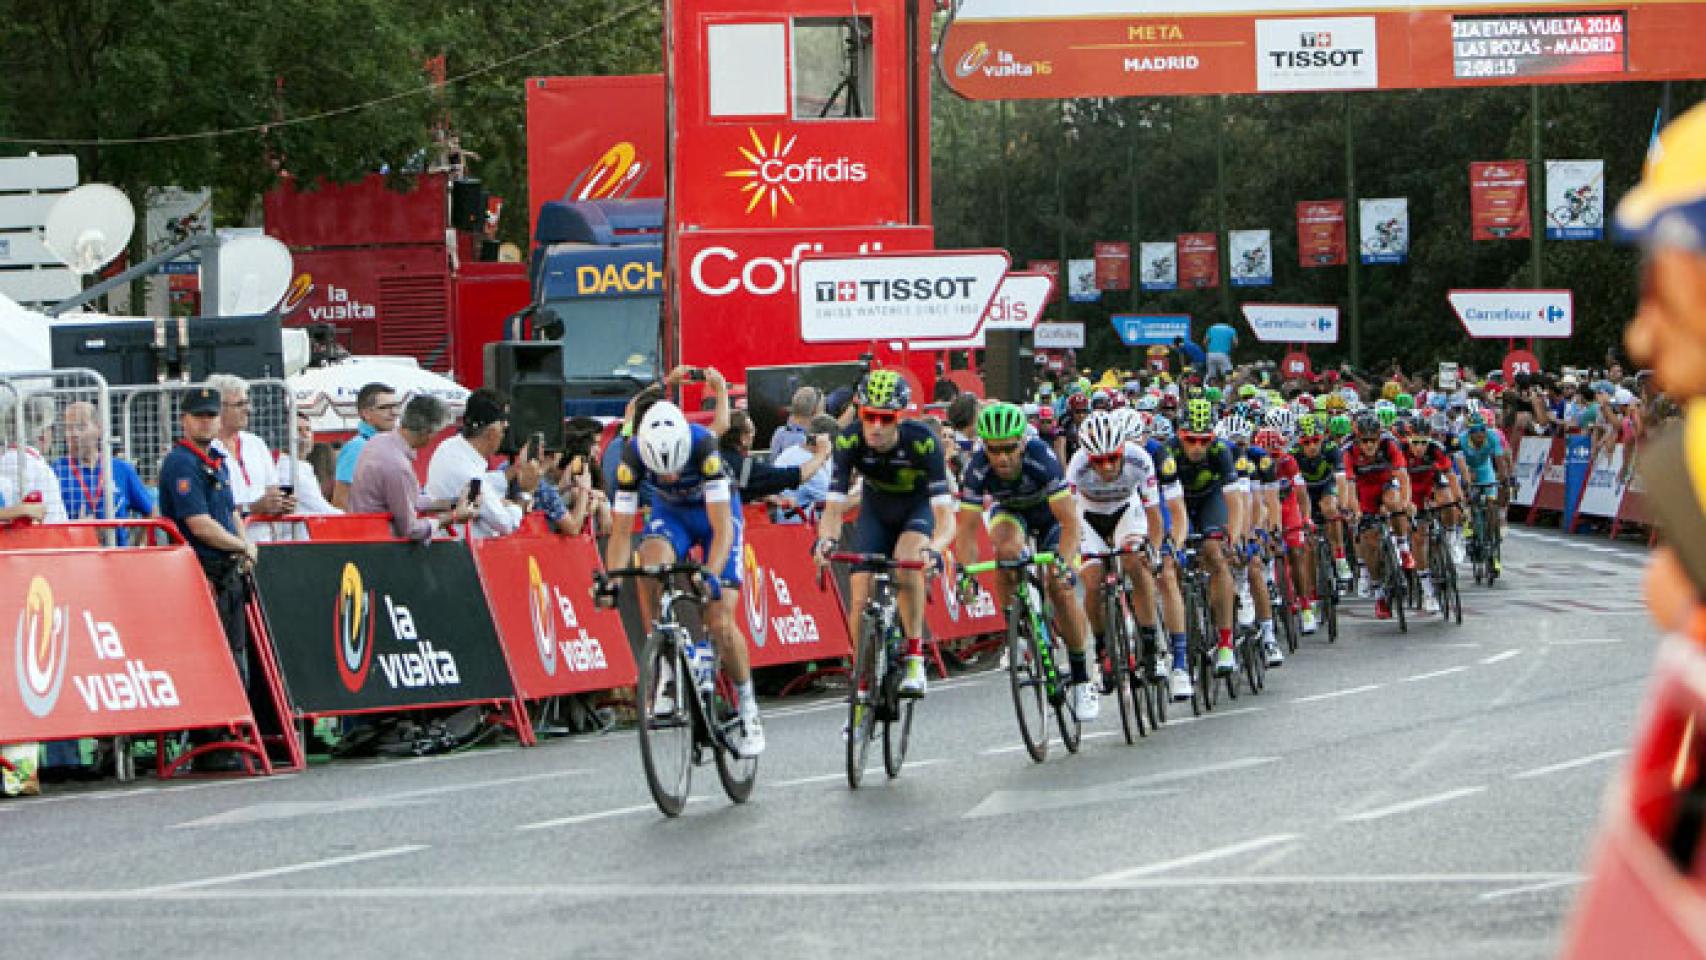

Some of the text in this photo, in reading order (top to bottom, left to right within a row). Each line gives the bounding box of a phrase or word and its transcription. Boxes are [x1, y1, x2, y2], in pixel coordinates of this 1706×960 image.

[1128, 25, 1183, 40] META
[1482, 20, 1527, 36] ETAPA
[1530, 19, 1583, 34] VUELTA
[1586, 17, 1622, 33] 2016
[998, 50, 1013, 62] la
[1269, 49, 1363, 68] TISSOT
[1458, 40, 1486, 56] LAS
[1490, 38, 1540, 54] ROZAS
[1554, 36, 1616, 52] MADRID
[1123, 55, 1199, 71] MADRID
[760, 157, 867, 184] Cofidis
[328, 284, 348, 302] la
[860, 276, 977, 302] TISSOT
[309, 301, 376, 319] vuelta
[1465, 307, 1531, 321] Carrefour
[769, 567, 792, 605] la
[385, 595, 417, 640] la
[554, 585, 578, 628] la
[82, 609, 126, 659] la
[771, 606, 820, 645] vuelta
[559, 629, 608, 672] vuelta
[377, 640, 460, 689] vuelta
[73, 659, 180, 711] vuelta
